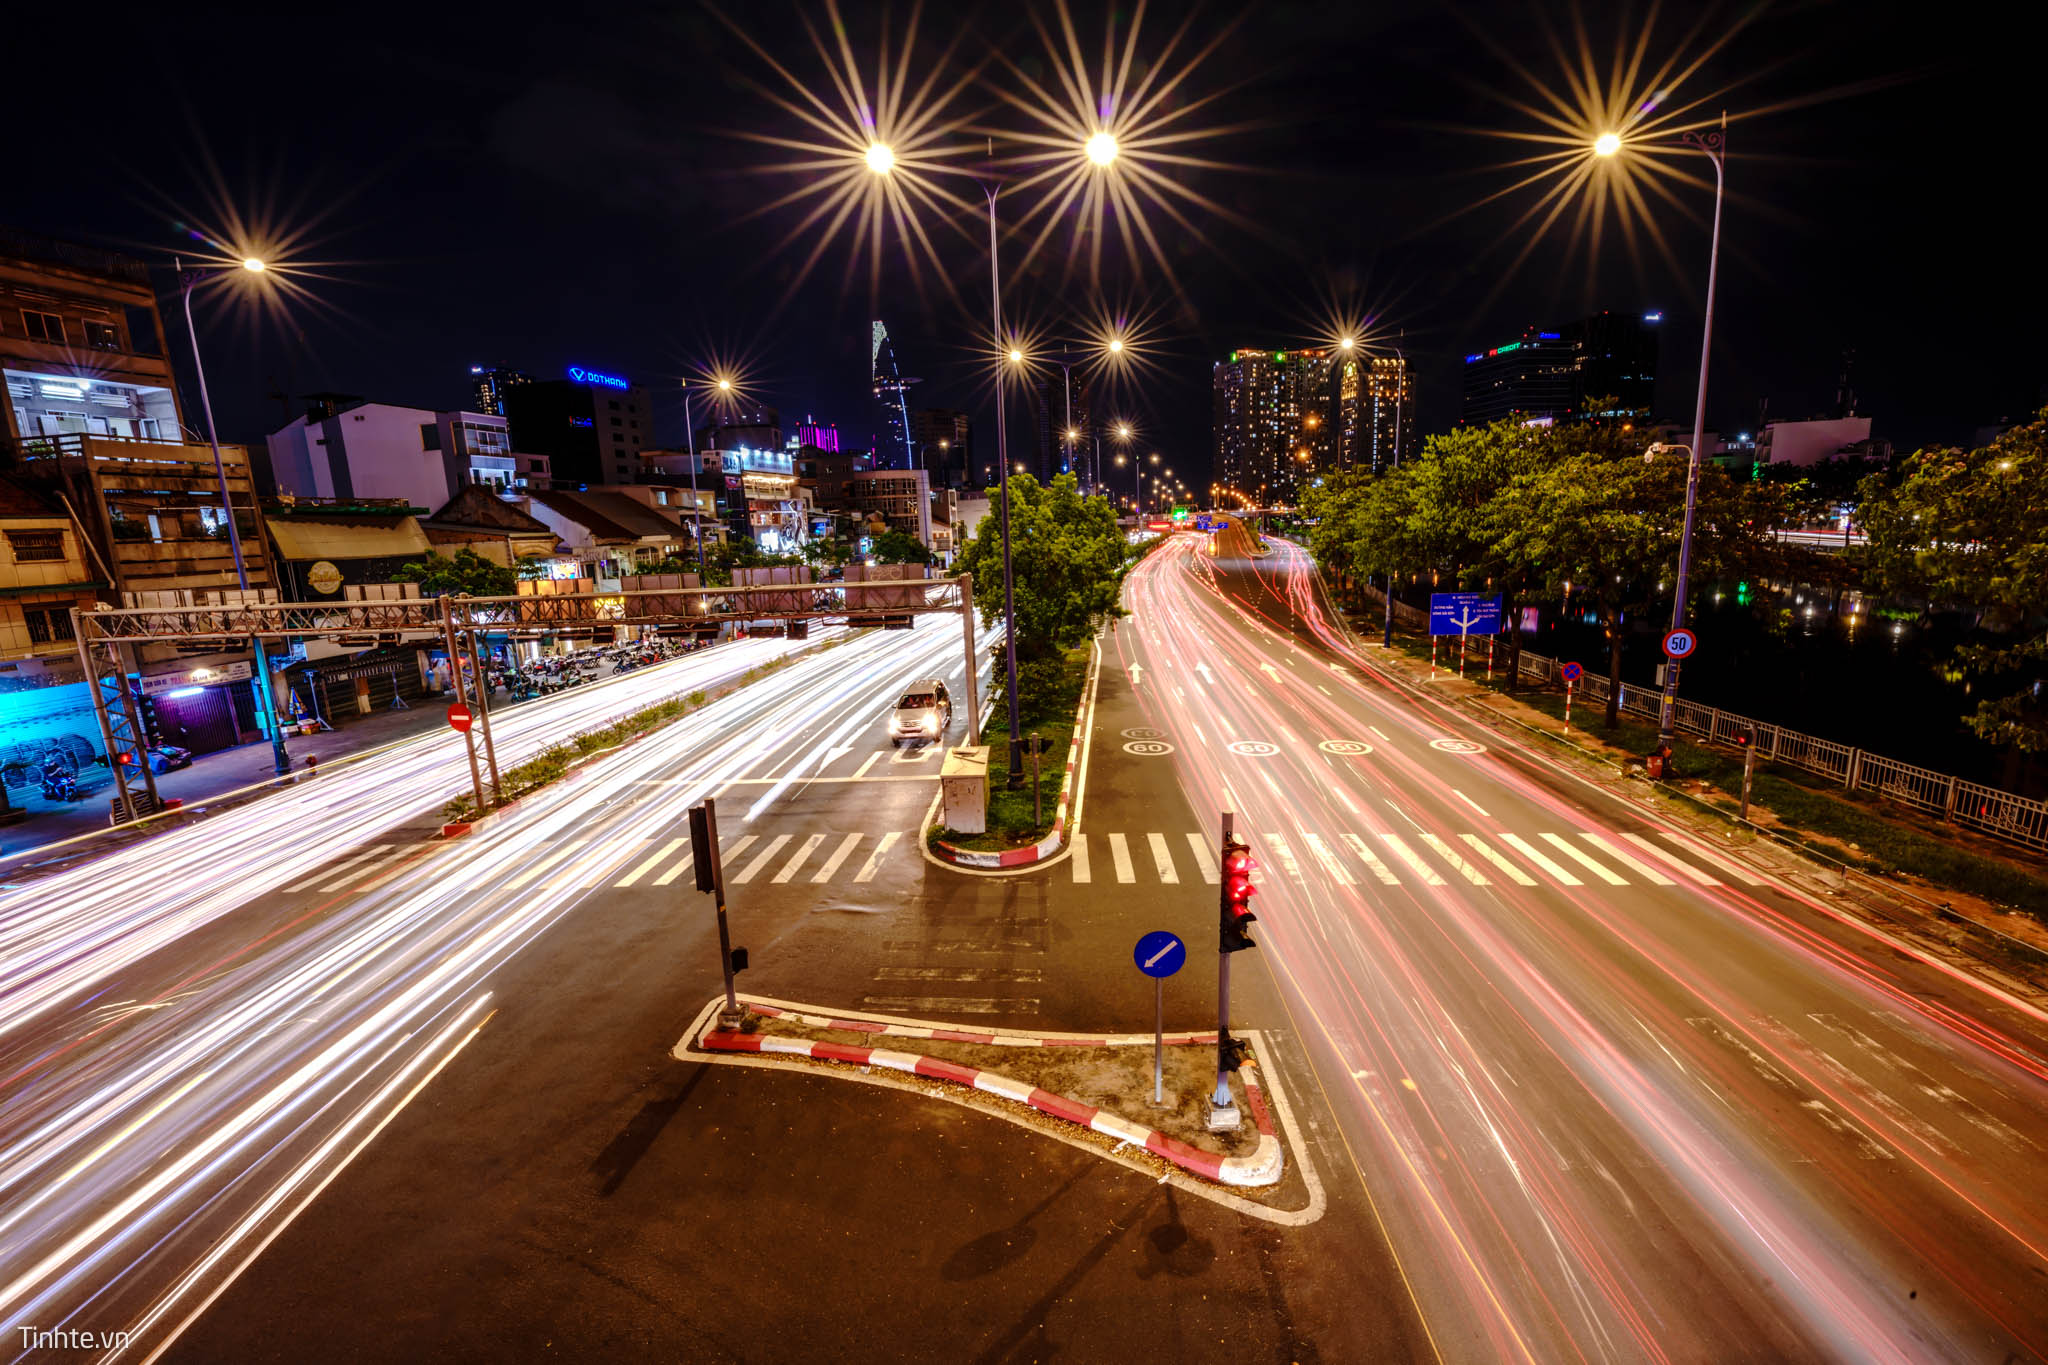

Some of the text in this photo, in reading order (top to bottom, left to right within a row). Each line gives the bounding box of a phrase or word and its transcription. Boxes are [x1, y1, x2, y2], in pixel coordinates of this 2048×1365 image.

[1497, 342, 1521, 354] CREDIT
[1671, 636, 1687, 651] 50
[1133, 744, 1163, 752] 60
